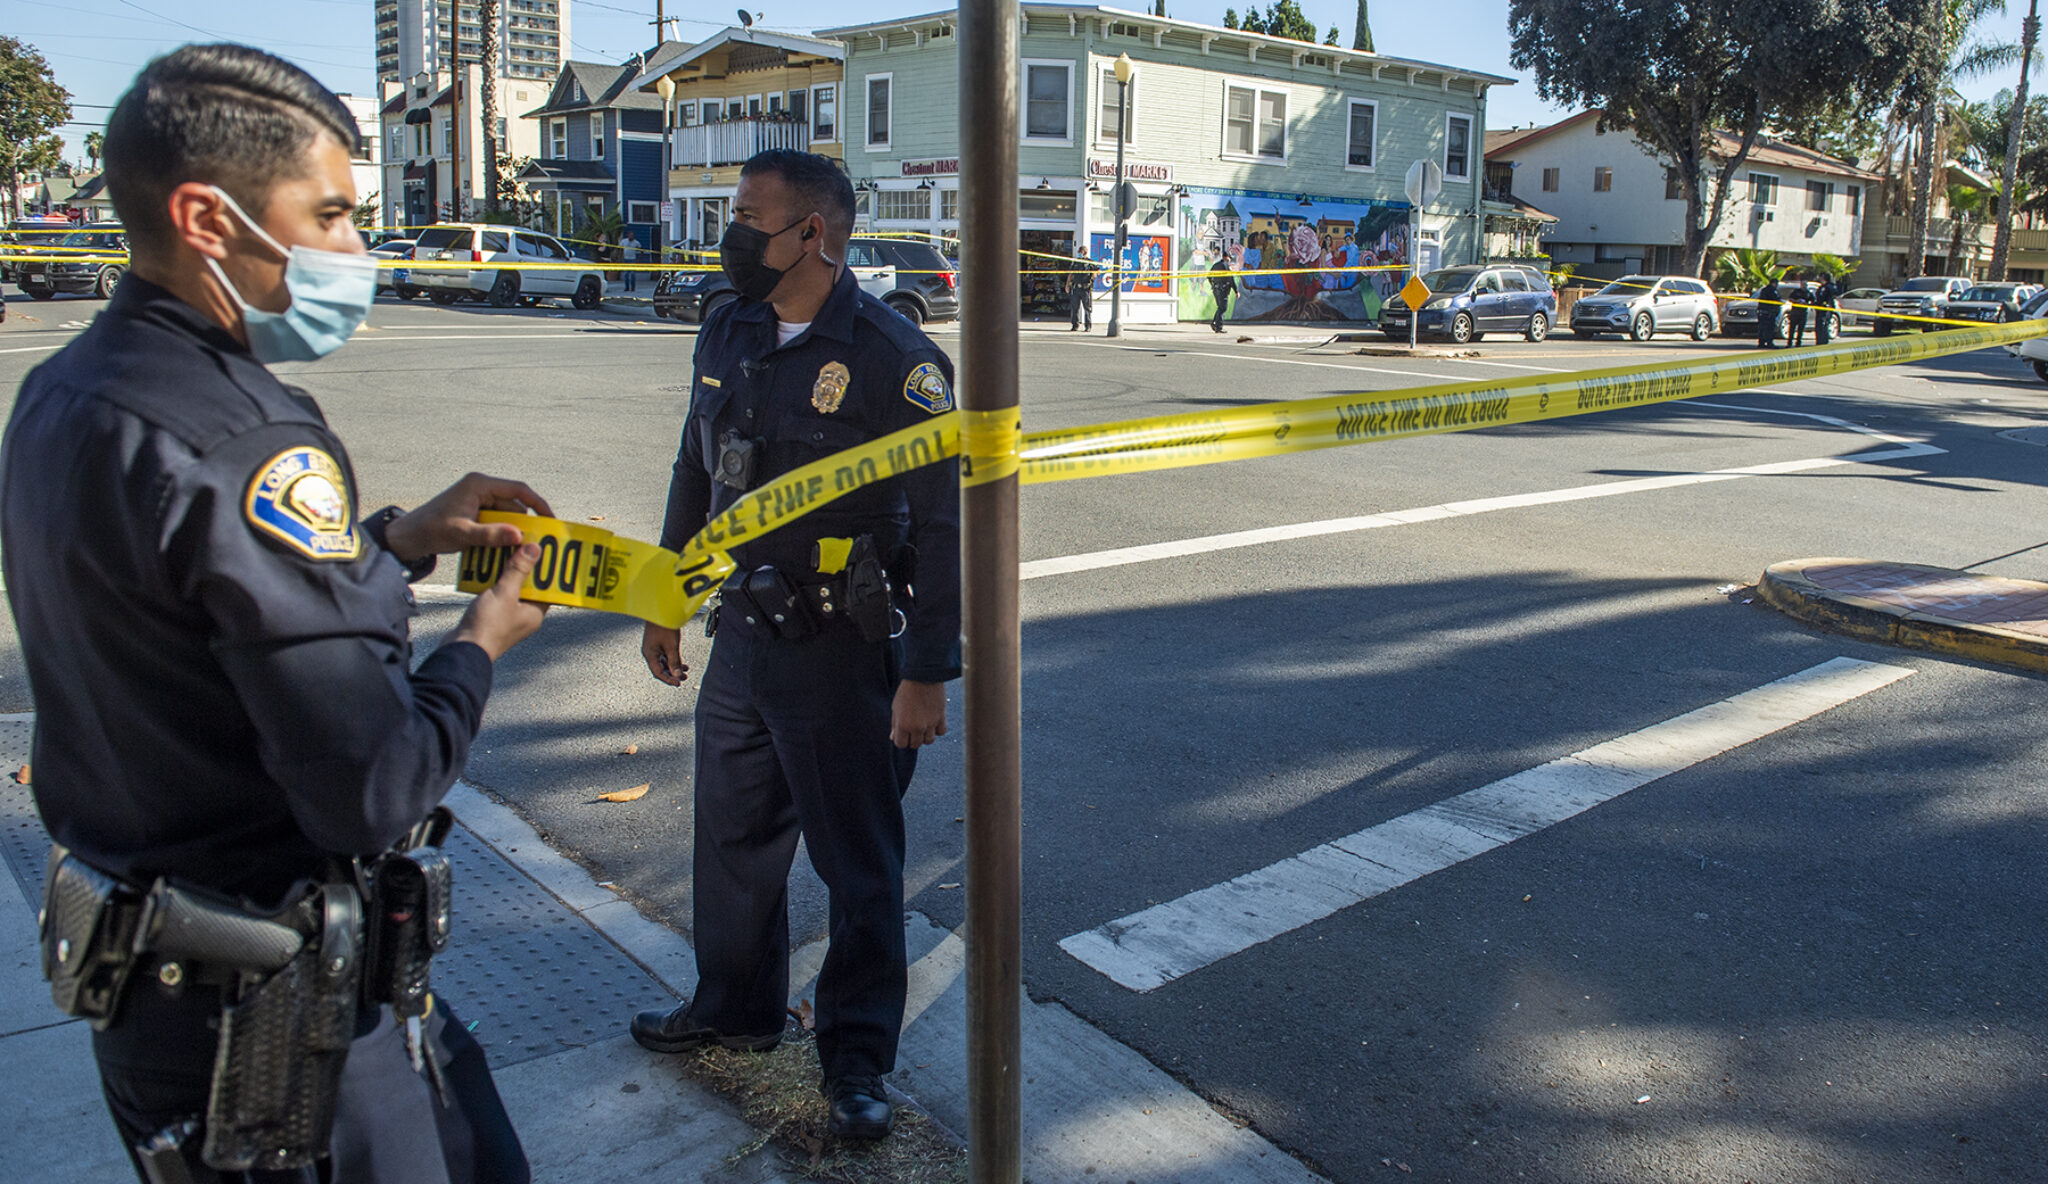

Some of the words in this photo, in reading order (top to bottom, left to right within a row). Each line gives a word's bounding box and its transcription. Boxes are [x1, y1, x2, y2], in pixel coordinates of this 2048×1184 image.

[908, 369, 924, 390] LONG
[257, 456, 303, 501] LONG
[310, 535, 353, 551] POLICE
[533, 534, 583, 594] DO
